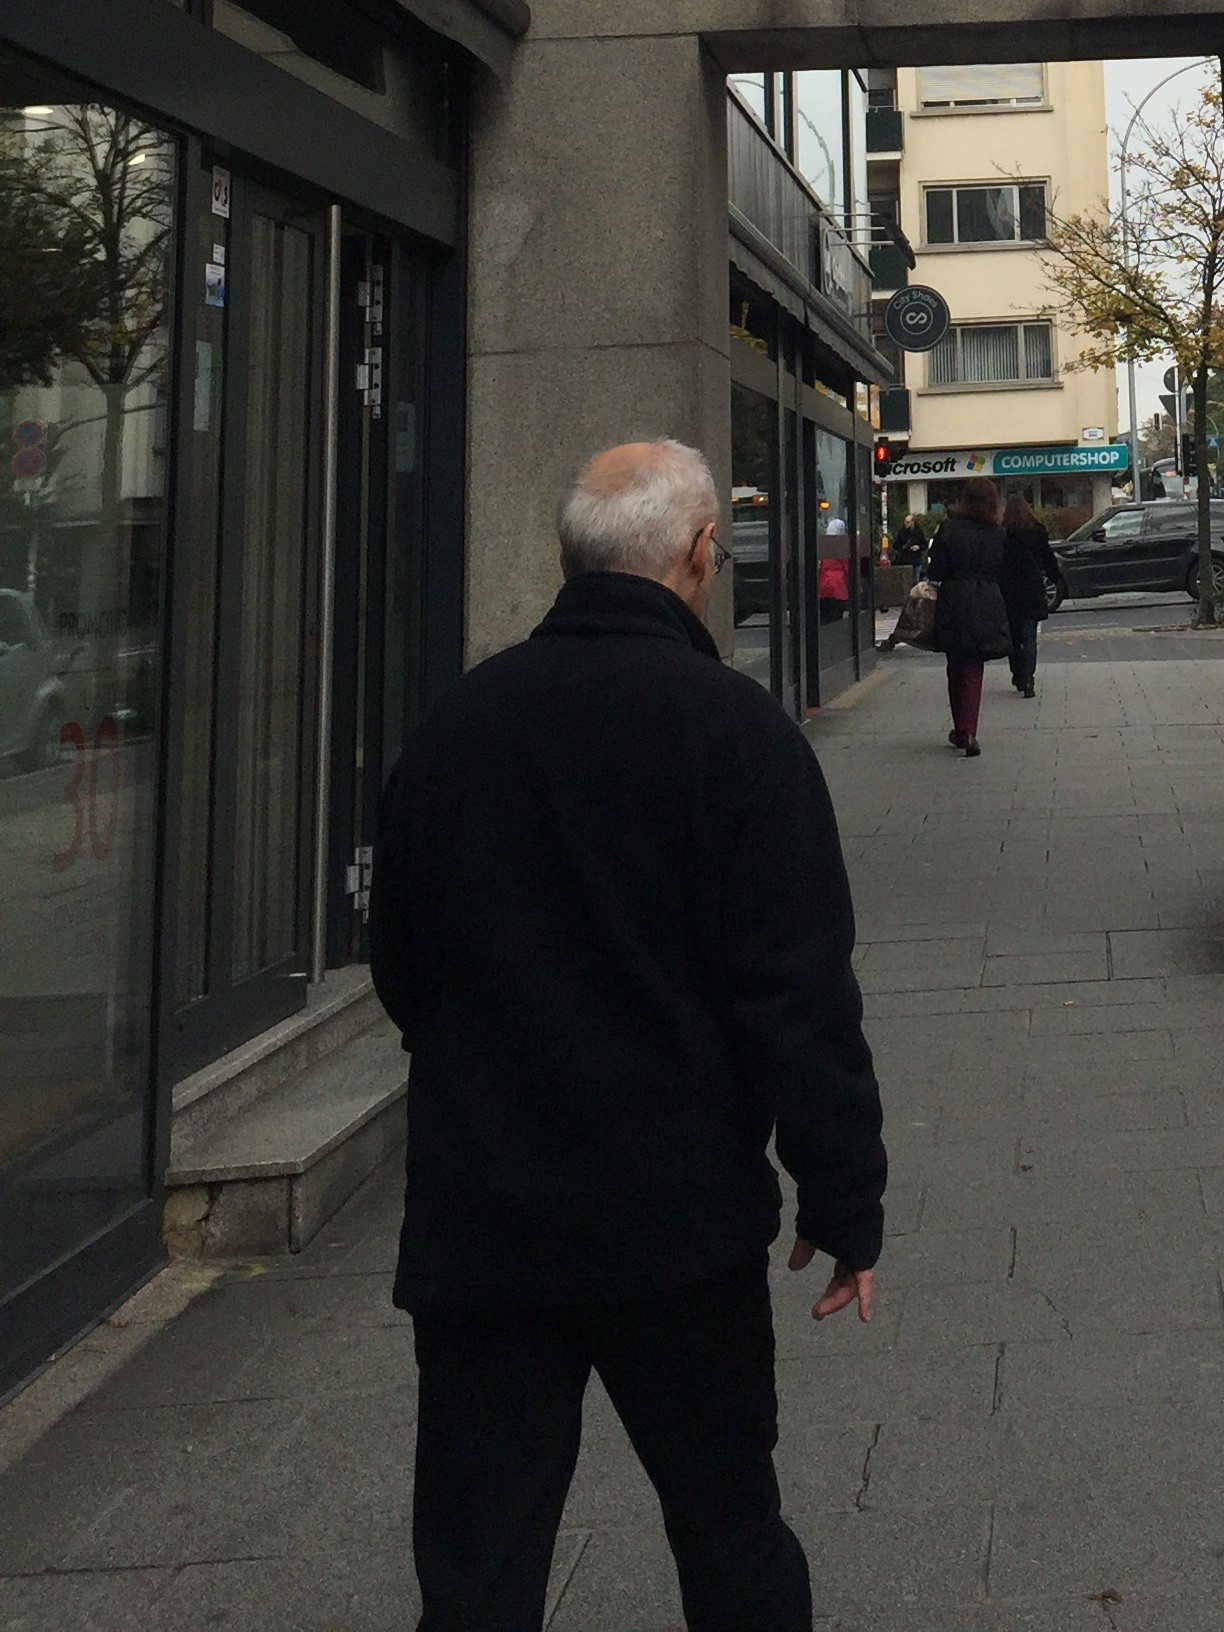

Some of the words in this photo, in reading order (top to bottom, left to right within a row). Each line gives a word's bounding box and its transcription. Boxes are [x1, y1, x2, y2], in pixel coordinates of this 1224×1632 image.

[893, 293, 910, 310] City
[911, 290, 939, 309] Shoes
[1001, 451, 1120, 469] COMPUTERSHOP
